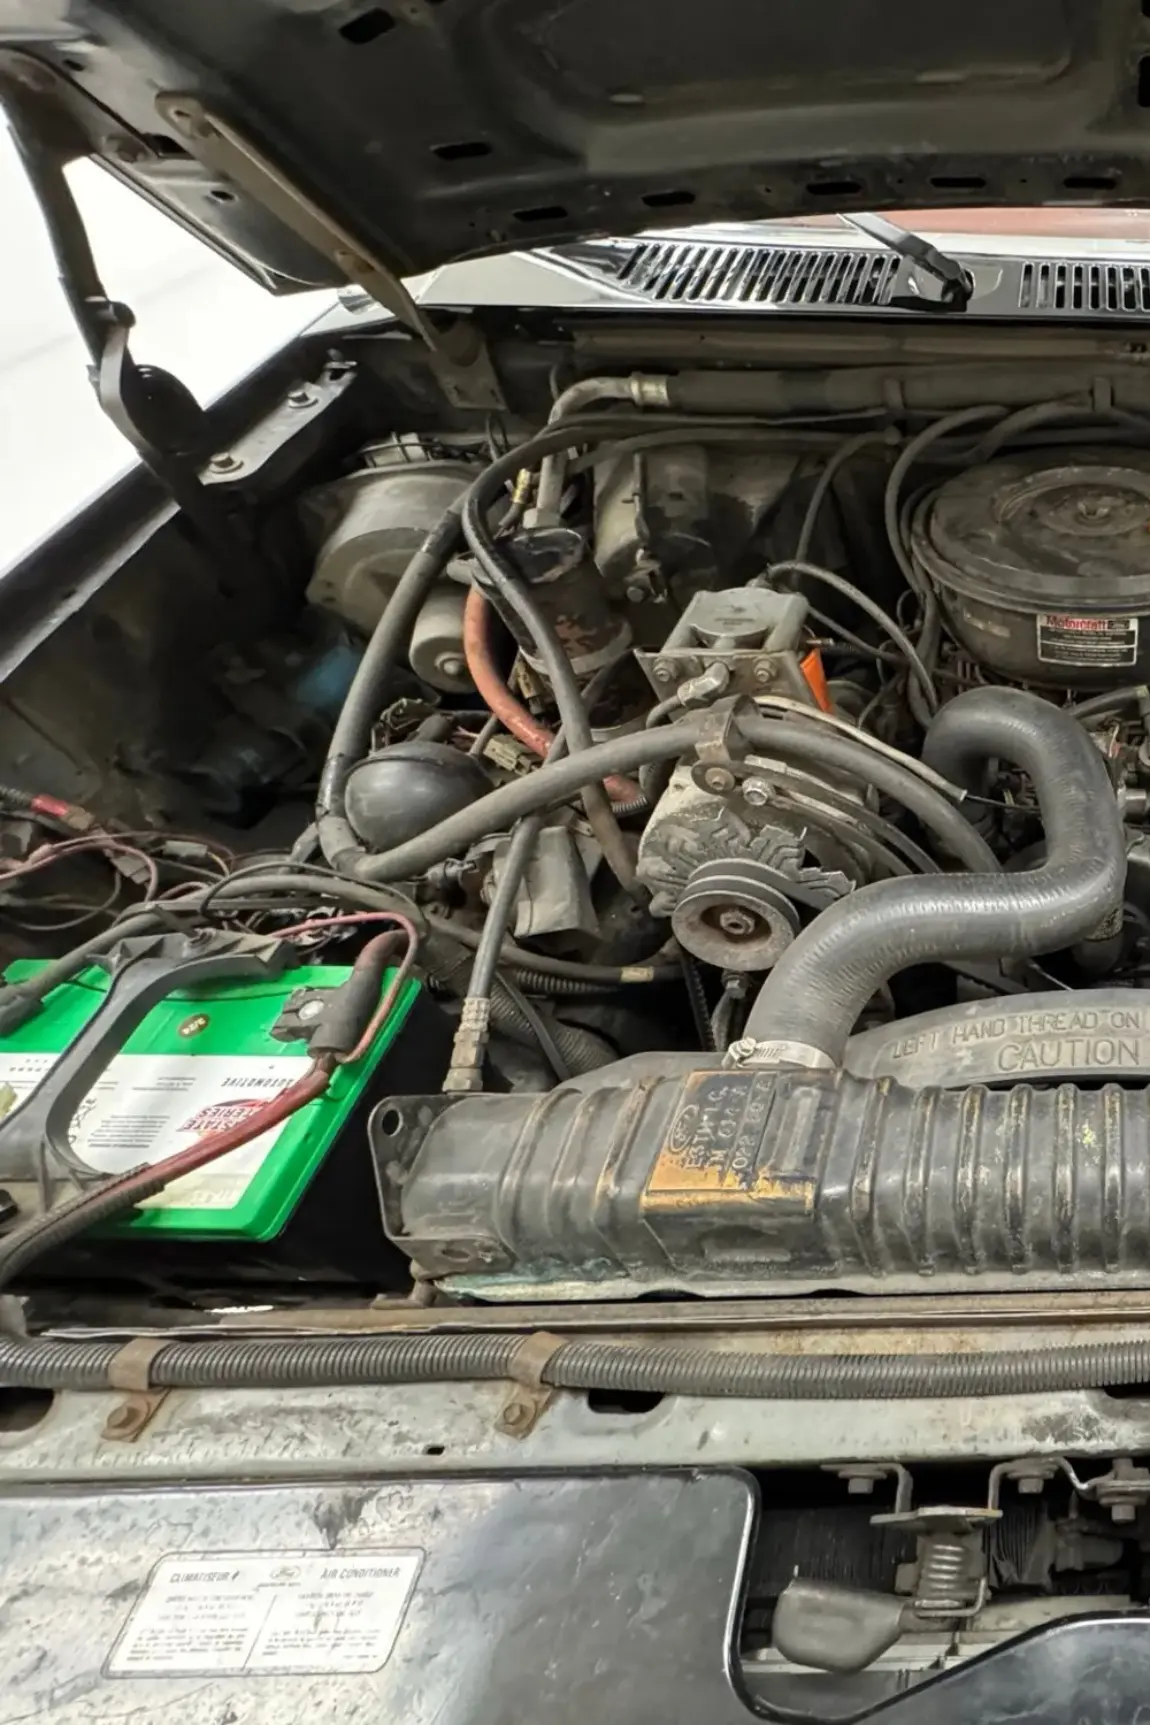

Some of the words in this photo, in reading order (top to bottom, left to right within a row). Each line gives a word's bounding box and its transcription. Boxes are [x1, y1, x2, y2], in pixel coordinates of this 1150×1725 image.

[892, 1029, 941, 1060] LEFT
[952, 1017, 1004, 1045] HAND
[1017, 1011, 1098, 1034] THREAD
[1112, 1010, 1140, 1030] ON
[998, 1039, 1140, 1073] CAUTION
[320, 1567, 338, 1580] AIR
[339, 1566, 401, 1580] CONDITIONER
